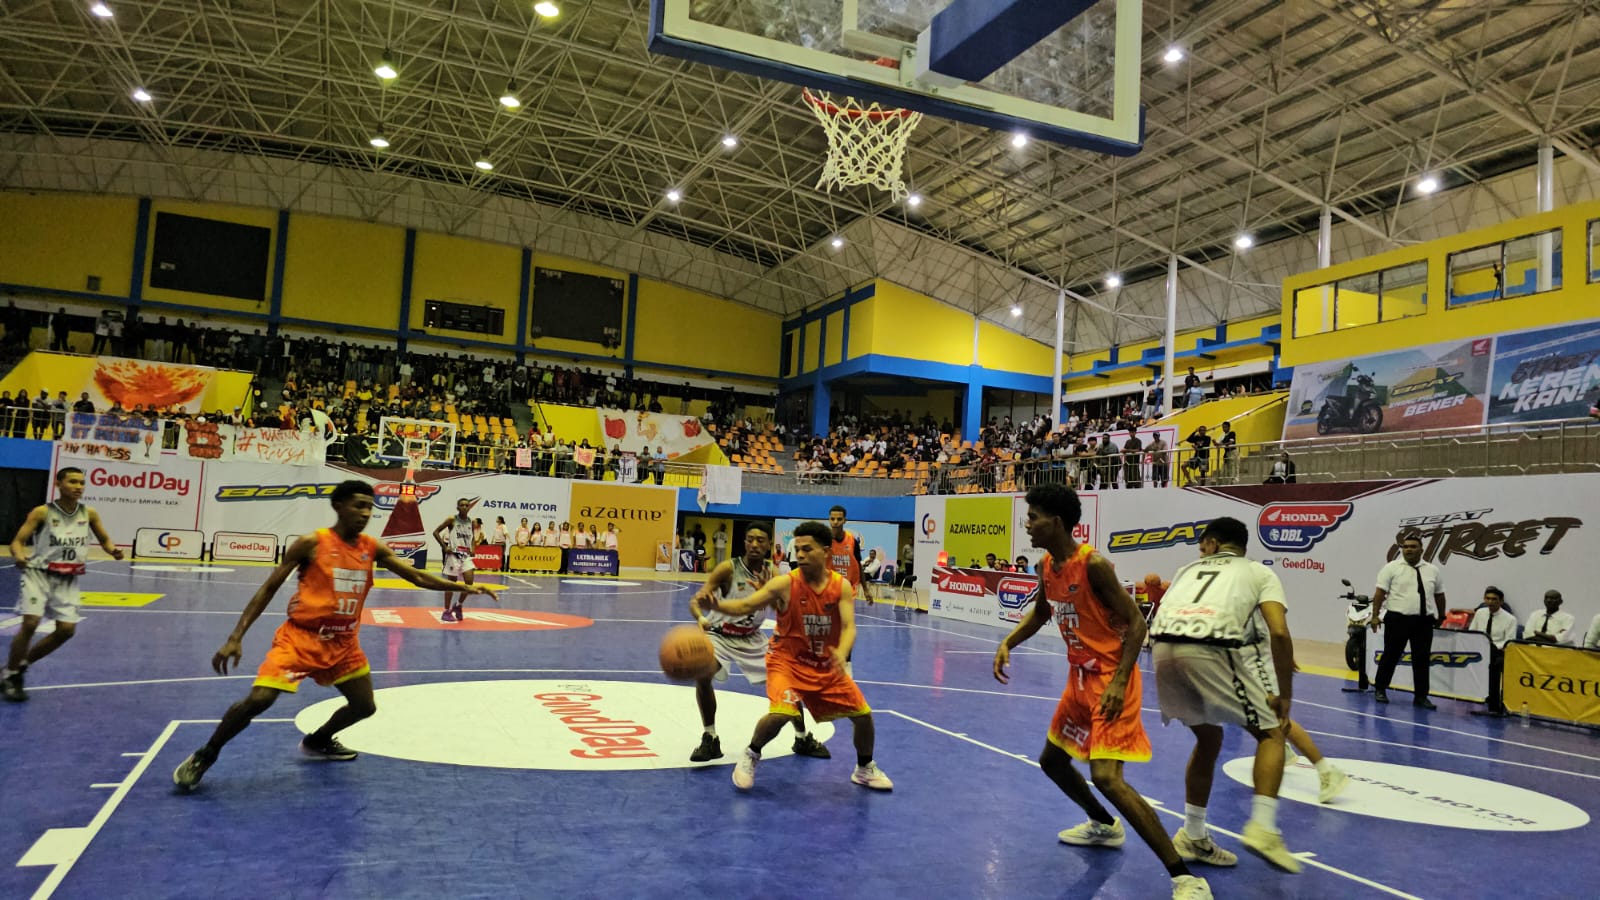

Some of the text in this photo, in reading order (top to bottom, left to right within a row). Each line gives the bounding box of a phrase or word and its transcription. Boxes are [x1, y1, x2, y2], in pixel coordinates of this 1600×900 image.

[1512, 384, 1591, 413] KAN!
[1403, 393, 1467, 418] BENER
[483, 500, 557, 512] ASTRA MOTOR
[1281, 514, 1329, 522] HONDA
[949, 524, 1006, 536] AZAWEAR.COM
[1280, 529, 1304, 542] DBL
[61, 549, 76, 561] 10
[949, 581, 983, 594] HONDA
[1192, 570, 1221, 604] 7
[334, 598, 358, 615] 10
[1424, 796, 1537, 825] MOTOR
